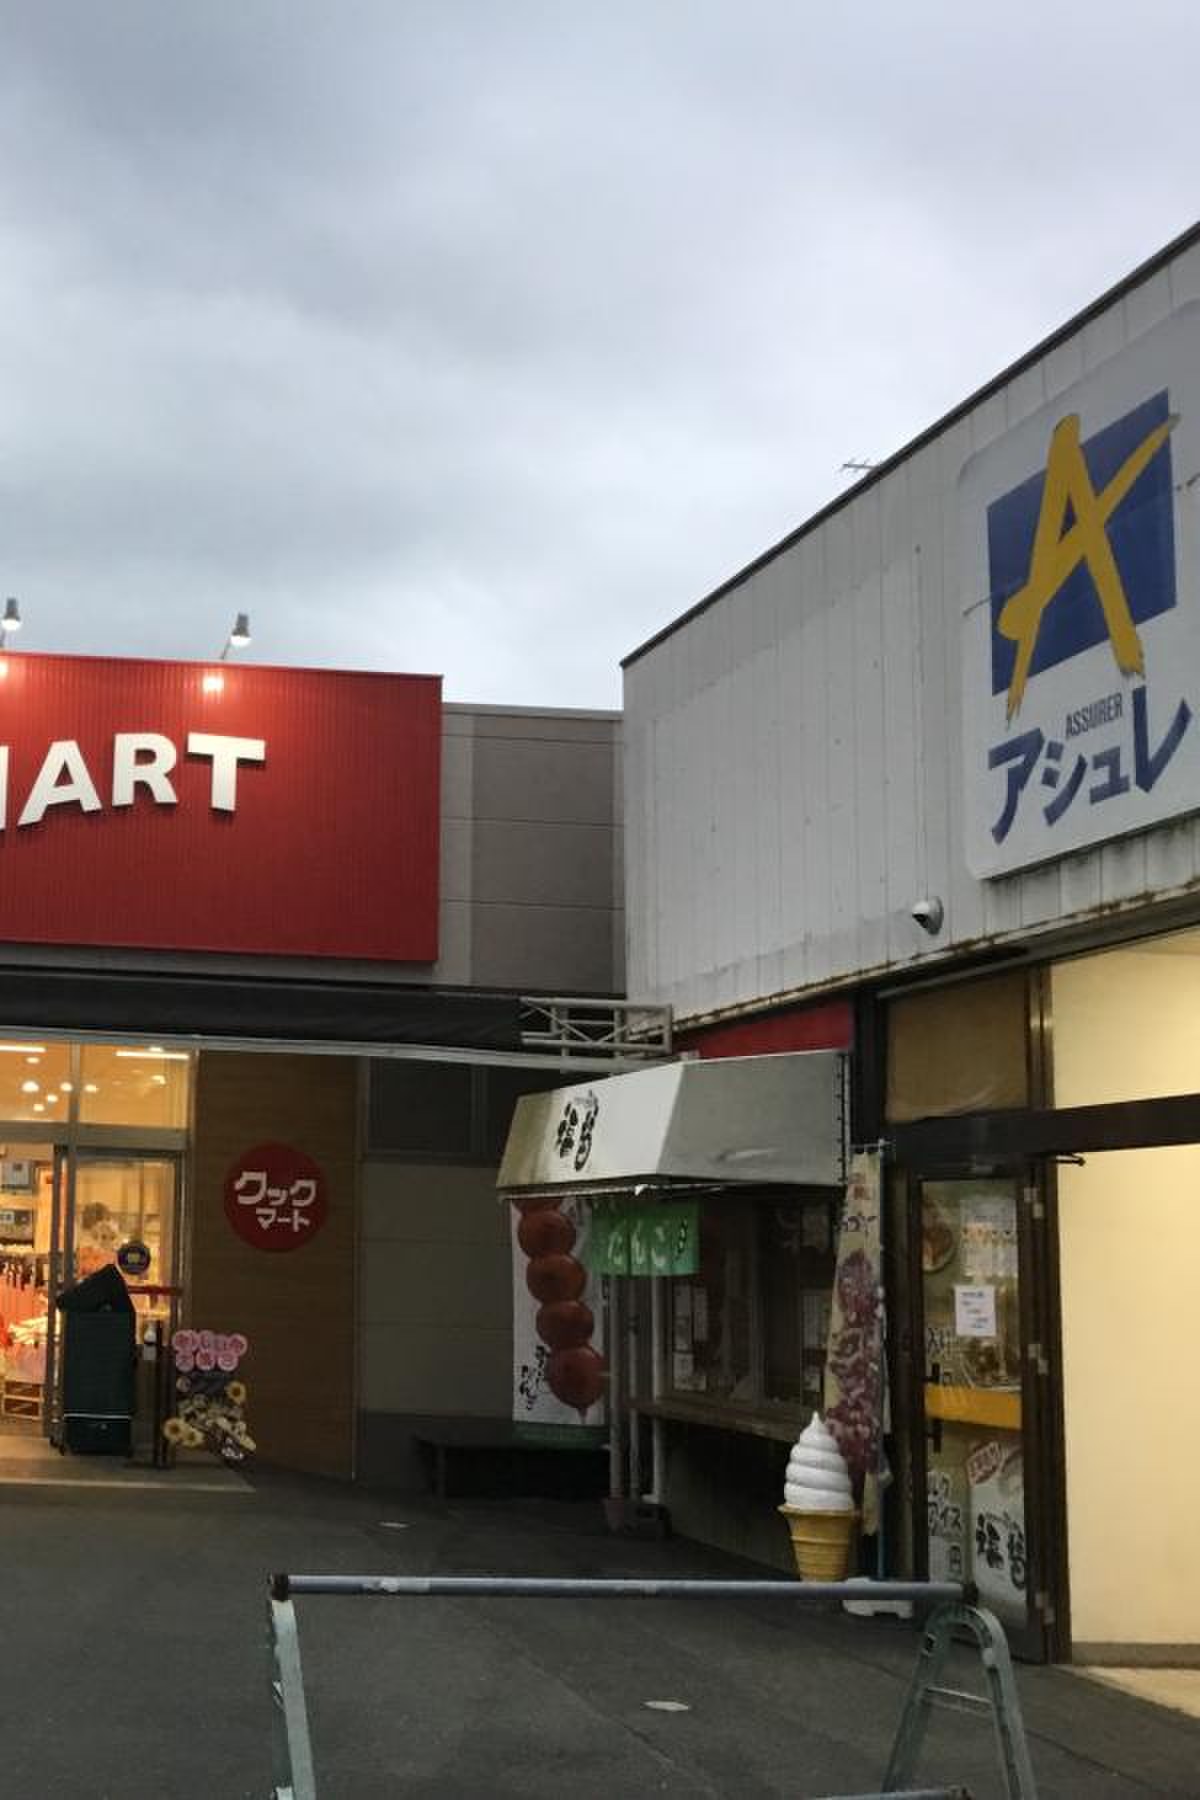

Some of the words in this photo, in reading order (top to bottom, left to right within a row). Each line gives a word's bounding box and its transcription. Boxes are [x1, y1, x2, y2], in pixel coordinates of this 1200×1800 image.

[1064, 692, 1124, 740] ASSURER
[987, 684, 1194, 846] アシュレ
[234, 1171, 317, 1206] クック
[255, 1207, 311, 1232] マート
